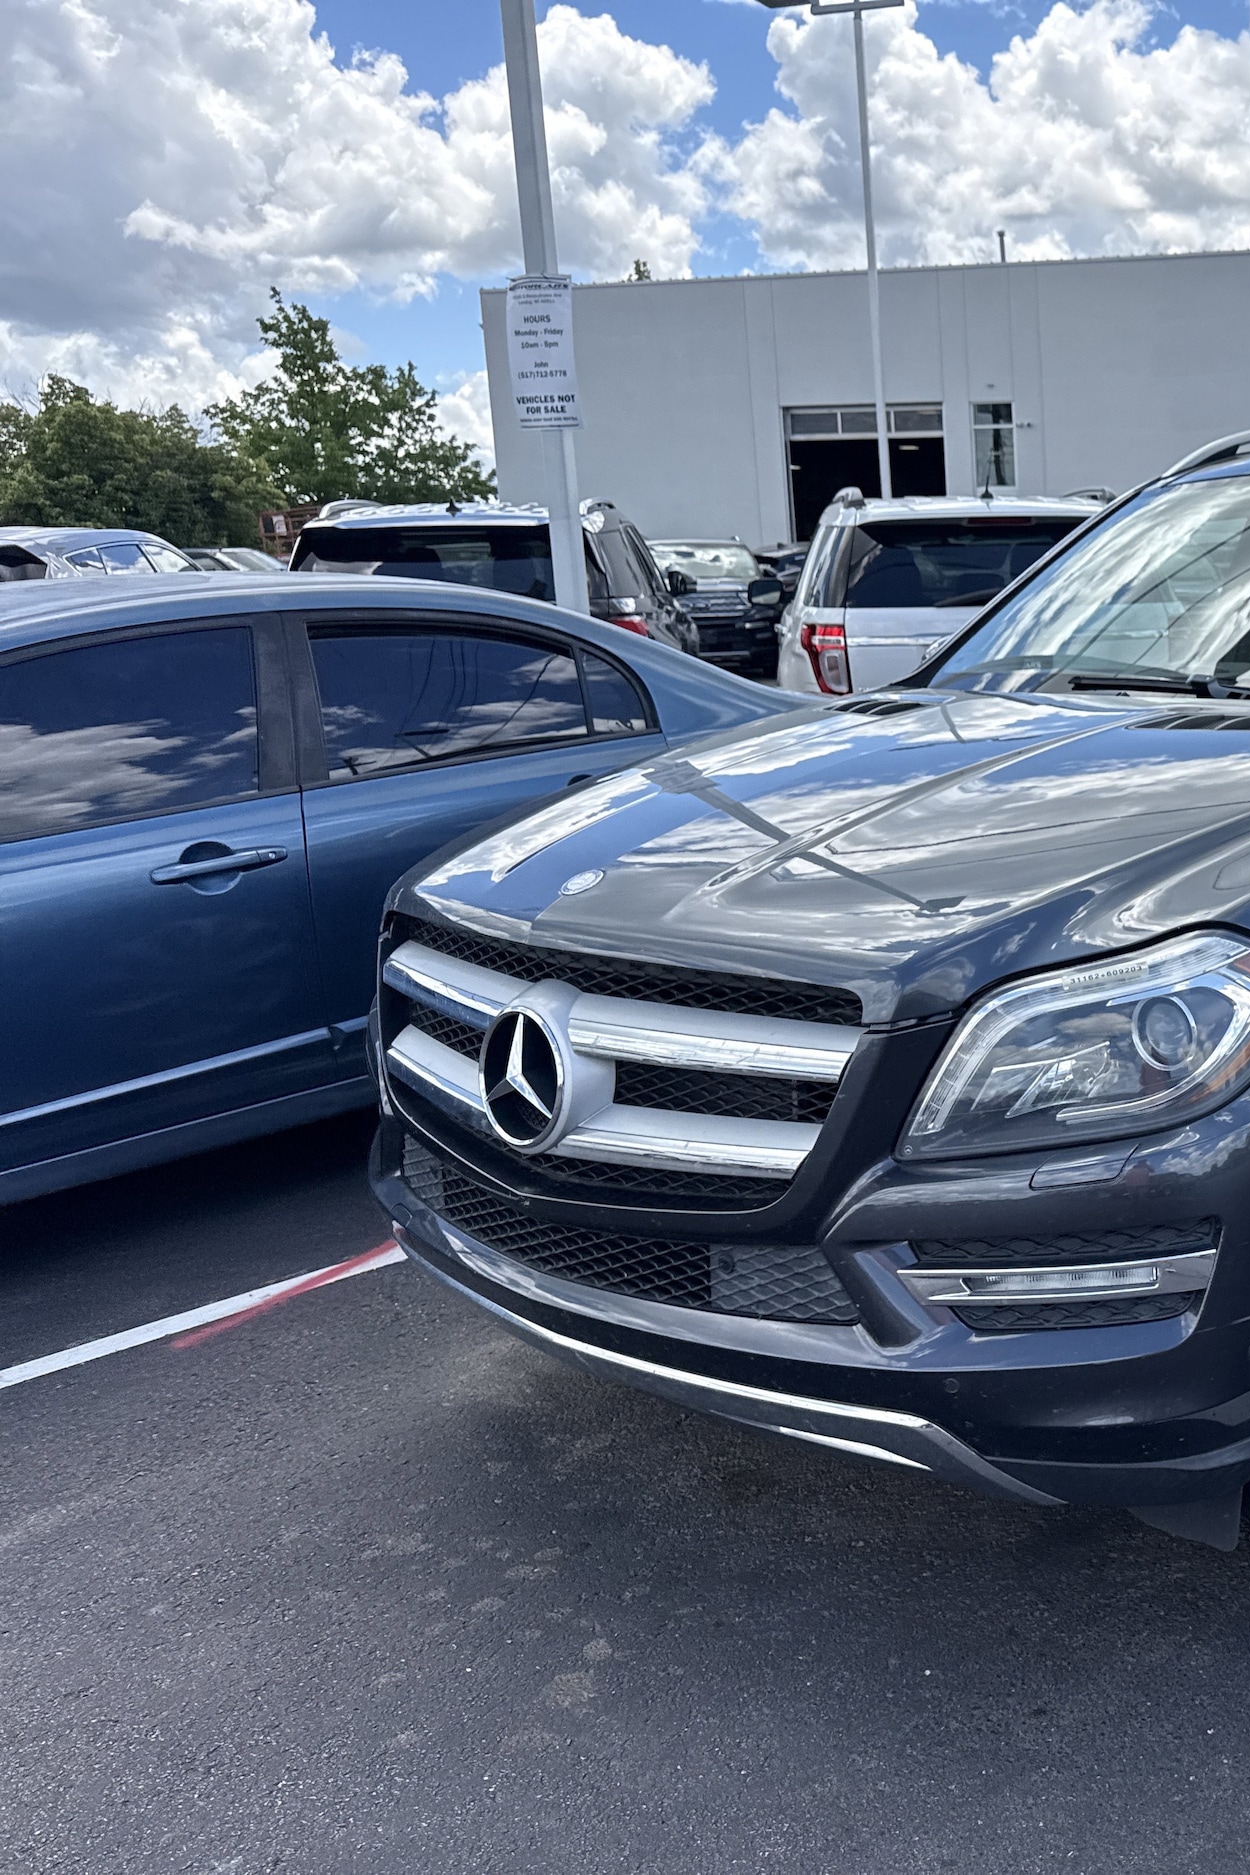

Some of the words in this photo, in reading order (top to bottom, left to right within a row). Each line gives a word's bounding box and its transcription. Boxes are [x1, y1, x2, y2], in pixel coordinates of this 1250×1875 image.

[523, 314, 551, 324] HOURS
[514, 329, 538, 338] Monday
[543, 328, 564, 336] Friday
[521, 341, 539, 349] 10am
[544, 340, 559, 349] 5pm
[516, 394, 555, 405] VEHICLES
[557, 394, 576, 403] NOT
[526, 406, 542, 415] FOR
[543, 405, 567, 414] SALE
